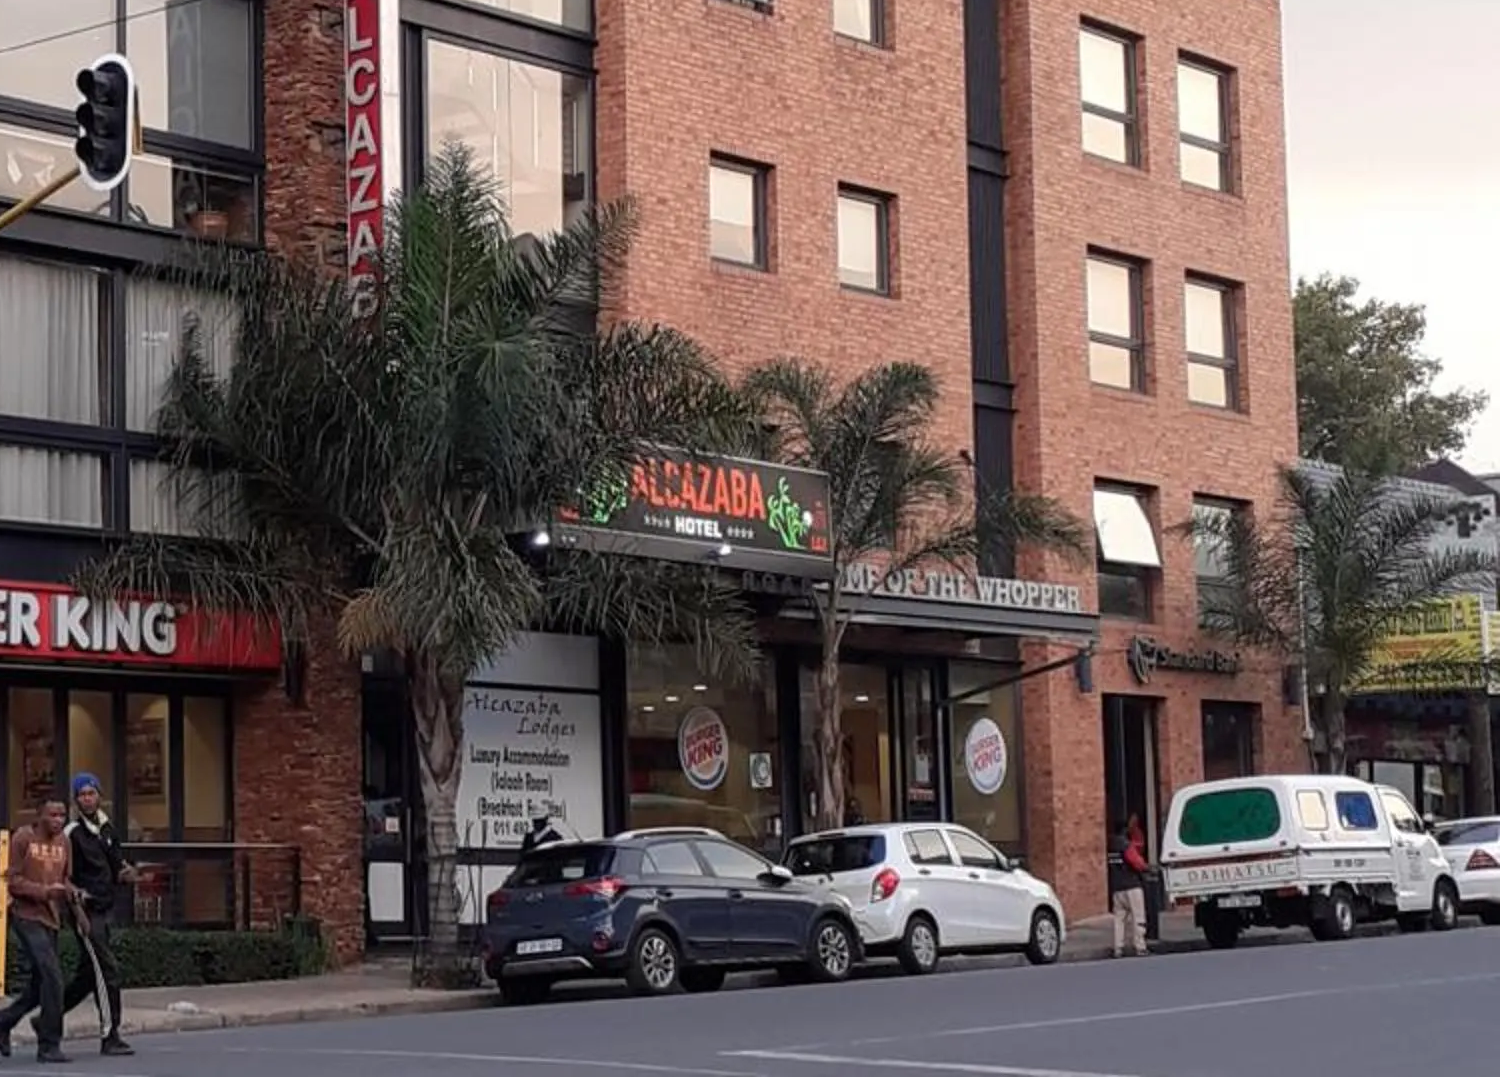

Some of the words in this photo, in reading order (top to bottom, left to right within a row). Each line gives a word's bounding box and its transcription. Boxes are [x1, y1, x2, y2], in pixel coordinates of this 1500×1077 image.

[629, 455, 766, 521] ALCAZABA
[675, 515, 722, 538] HOTEL
[886, 568, 918, 597] OF
[977, 576, 1080, 612] WHOPPER
[53, 594, 177, 654] KING
[517, 717, 576, 745] Lodges
[470, 742, 500, 767] Luxury
[684, 738, 723, 768] KING
[1187, 862, 1278, 883] DAIHATSU
